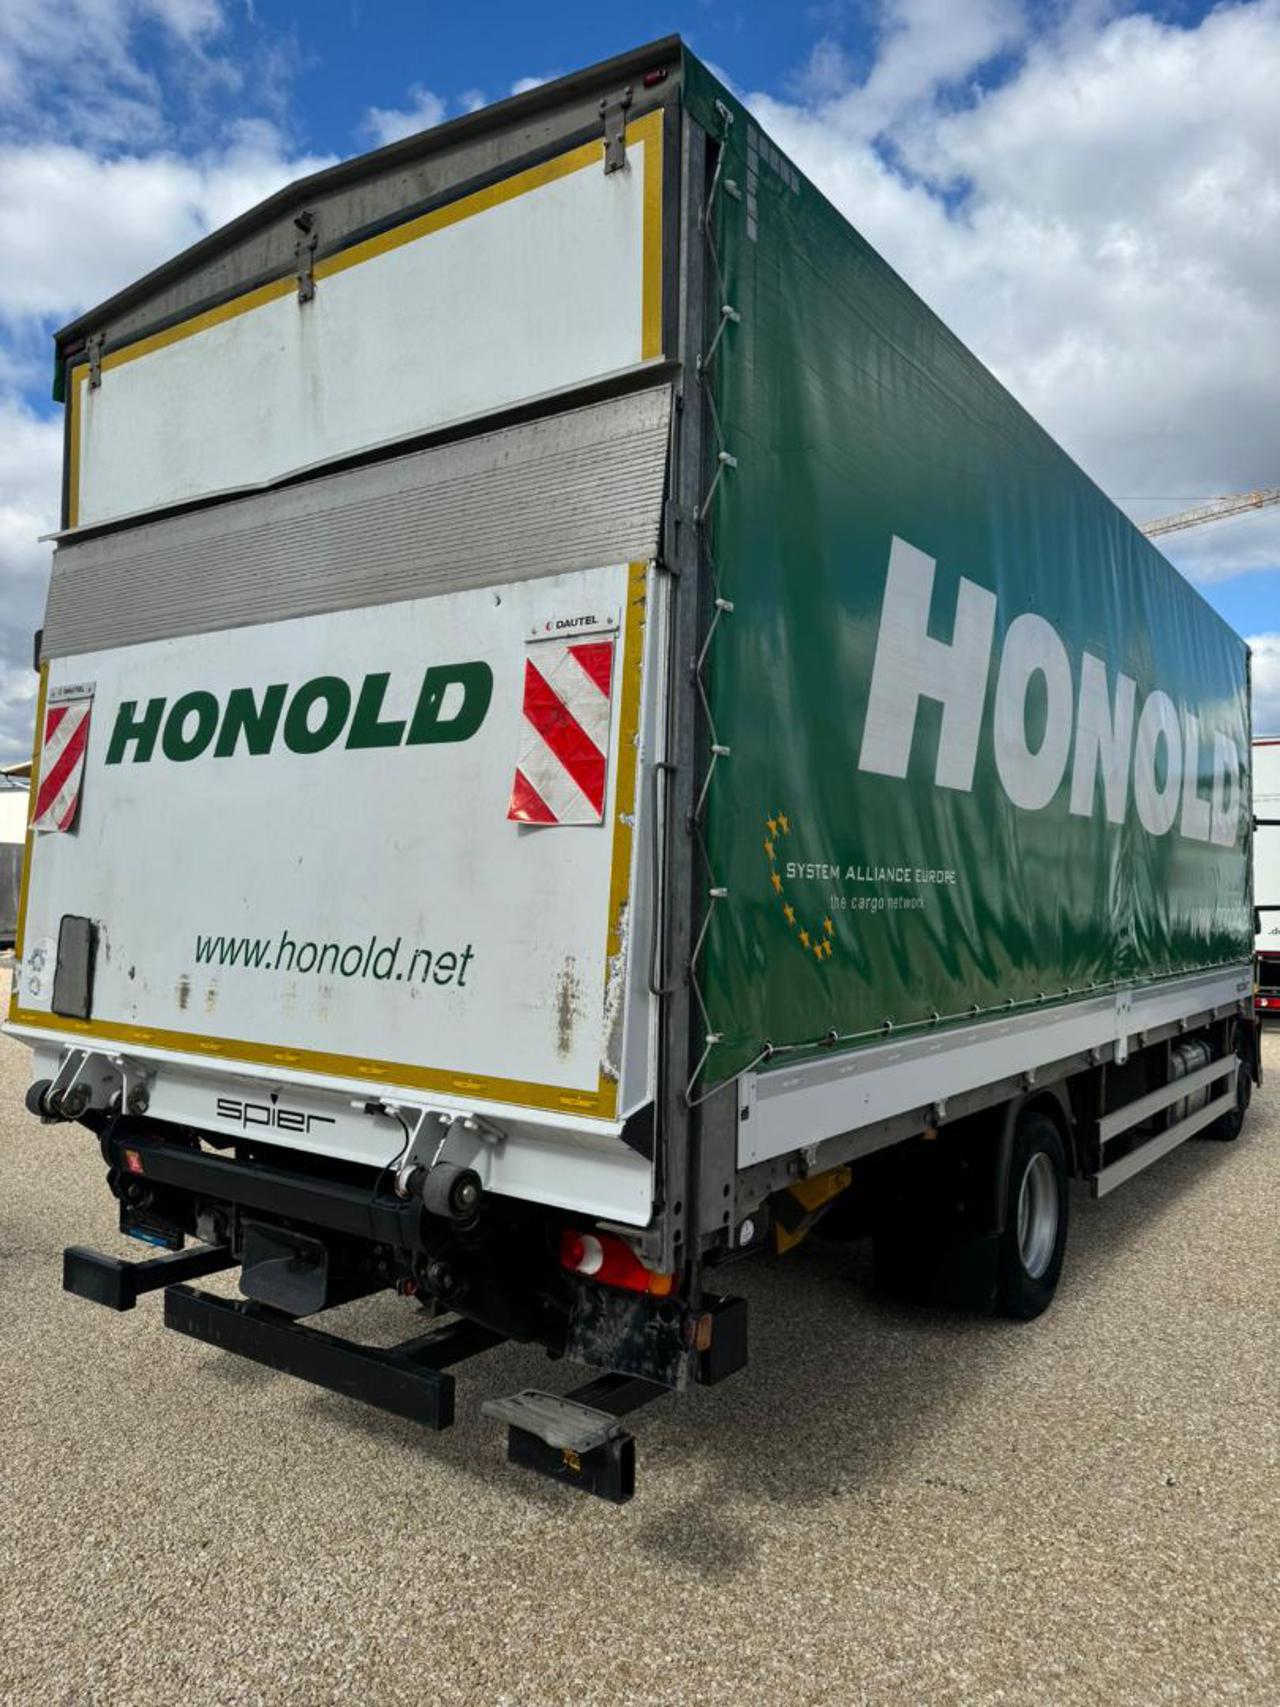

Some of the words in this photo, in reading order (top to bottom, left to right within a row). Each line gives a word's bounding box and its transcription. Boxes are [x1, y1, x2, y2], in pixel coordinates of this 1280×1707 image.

[555, 615, 598, 629] DAUTEL
[857, 534, 1240, 848] HONOLD
[104, 661, 494, 766] HONOLD
[786, 862, 840, 880] SYSTEM
[845, 866, 911, 883] ALLIANCE
[915, 868, 956, 885] EUROPE
[830, 894, 847, 910] the
[851, 895, 884, 913] cargo
[195, 930, 474, 987] www.honold.net
[217, 1098, 336, 1134] spier
